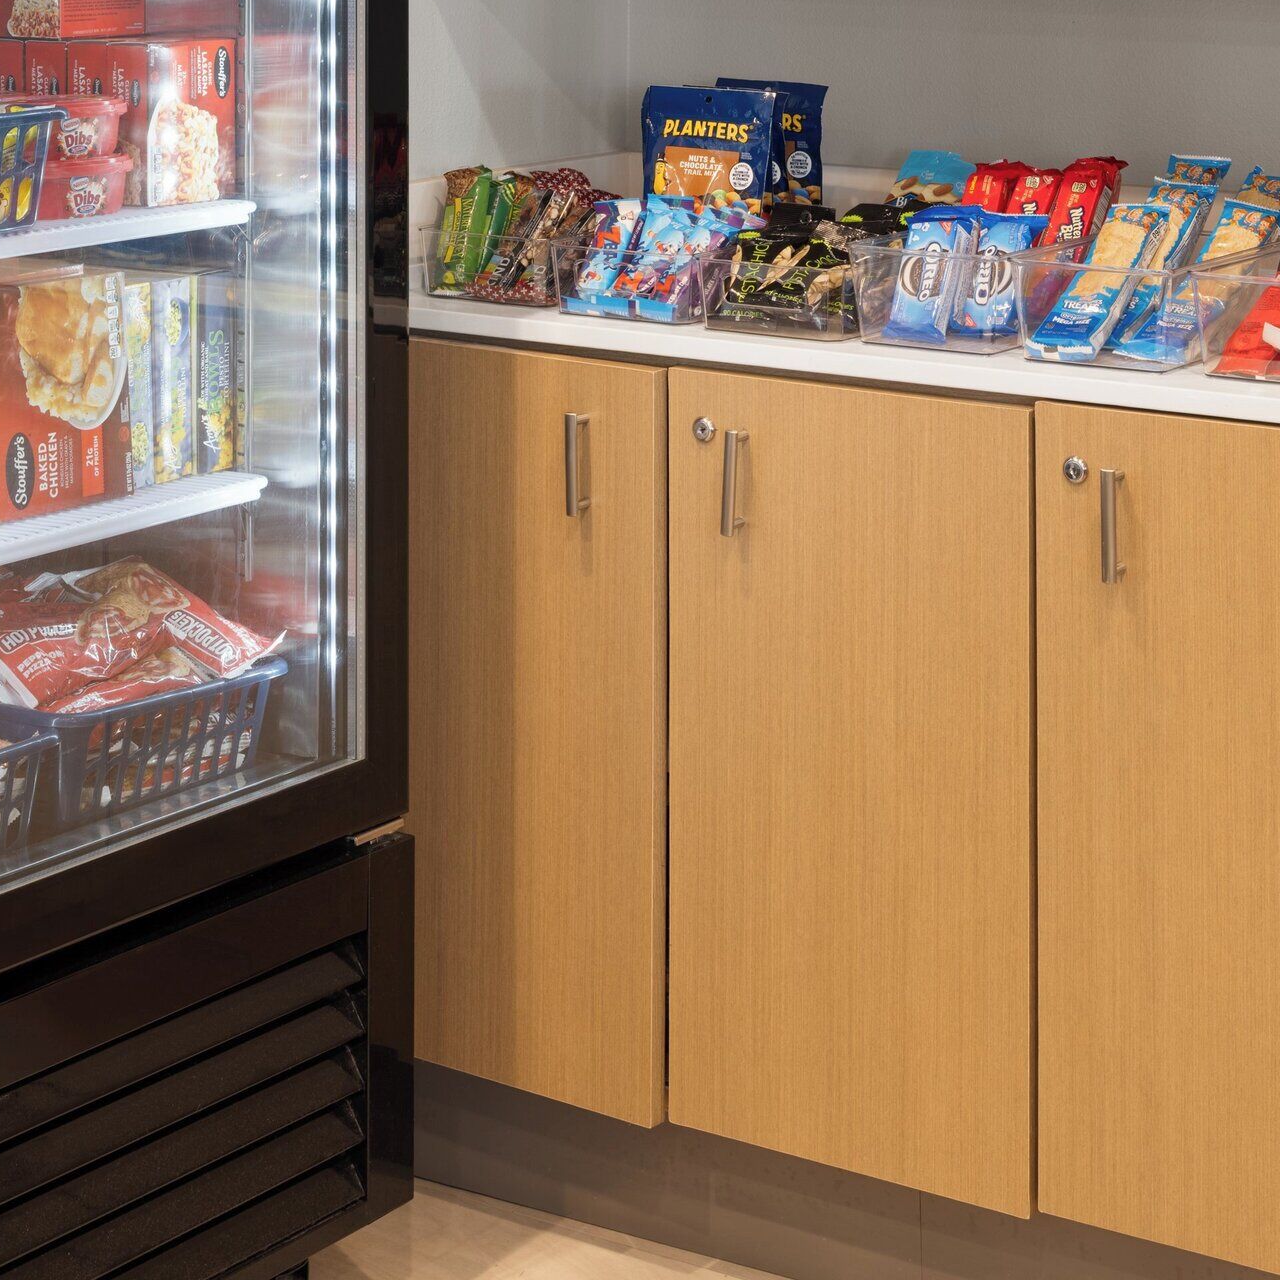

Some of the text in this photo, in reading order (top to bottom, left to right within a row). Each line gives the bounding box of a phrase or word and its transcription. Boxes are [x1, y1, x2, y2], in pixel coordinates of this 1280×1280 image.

[217, 48, 227, 98] Stouffer's
[64, 133, 94, 149] Dibs
[663, 119, 750, 144] PLANTERS
[679, 161, 724, 172] CHOCOLATE
[688, 154, 711, 164] NUTS
[683, 168, 702, 176] TRAIL
[73, 191, 102, 207] Dibs
[917, 242, 942, 302] OREO
[15, 436, 28, 505] Stouffer's
[38, 442, 48, 491] BAKED
[48, 431, 58, 498] CHICKEN
